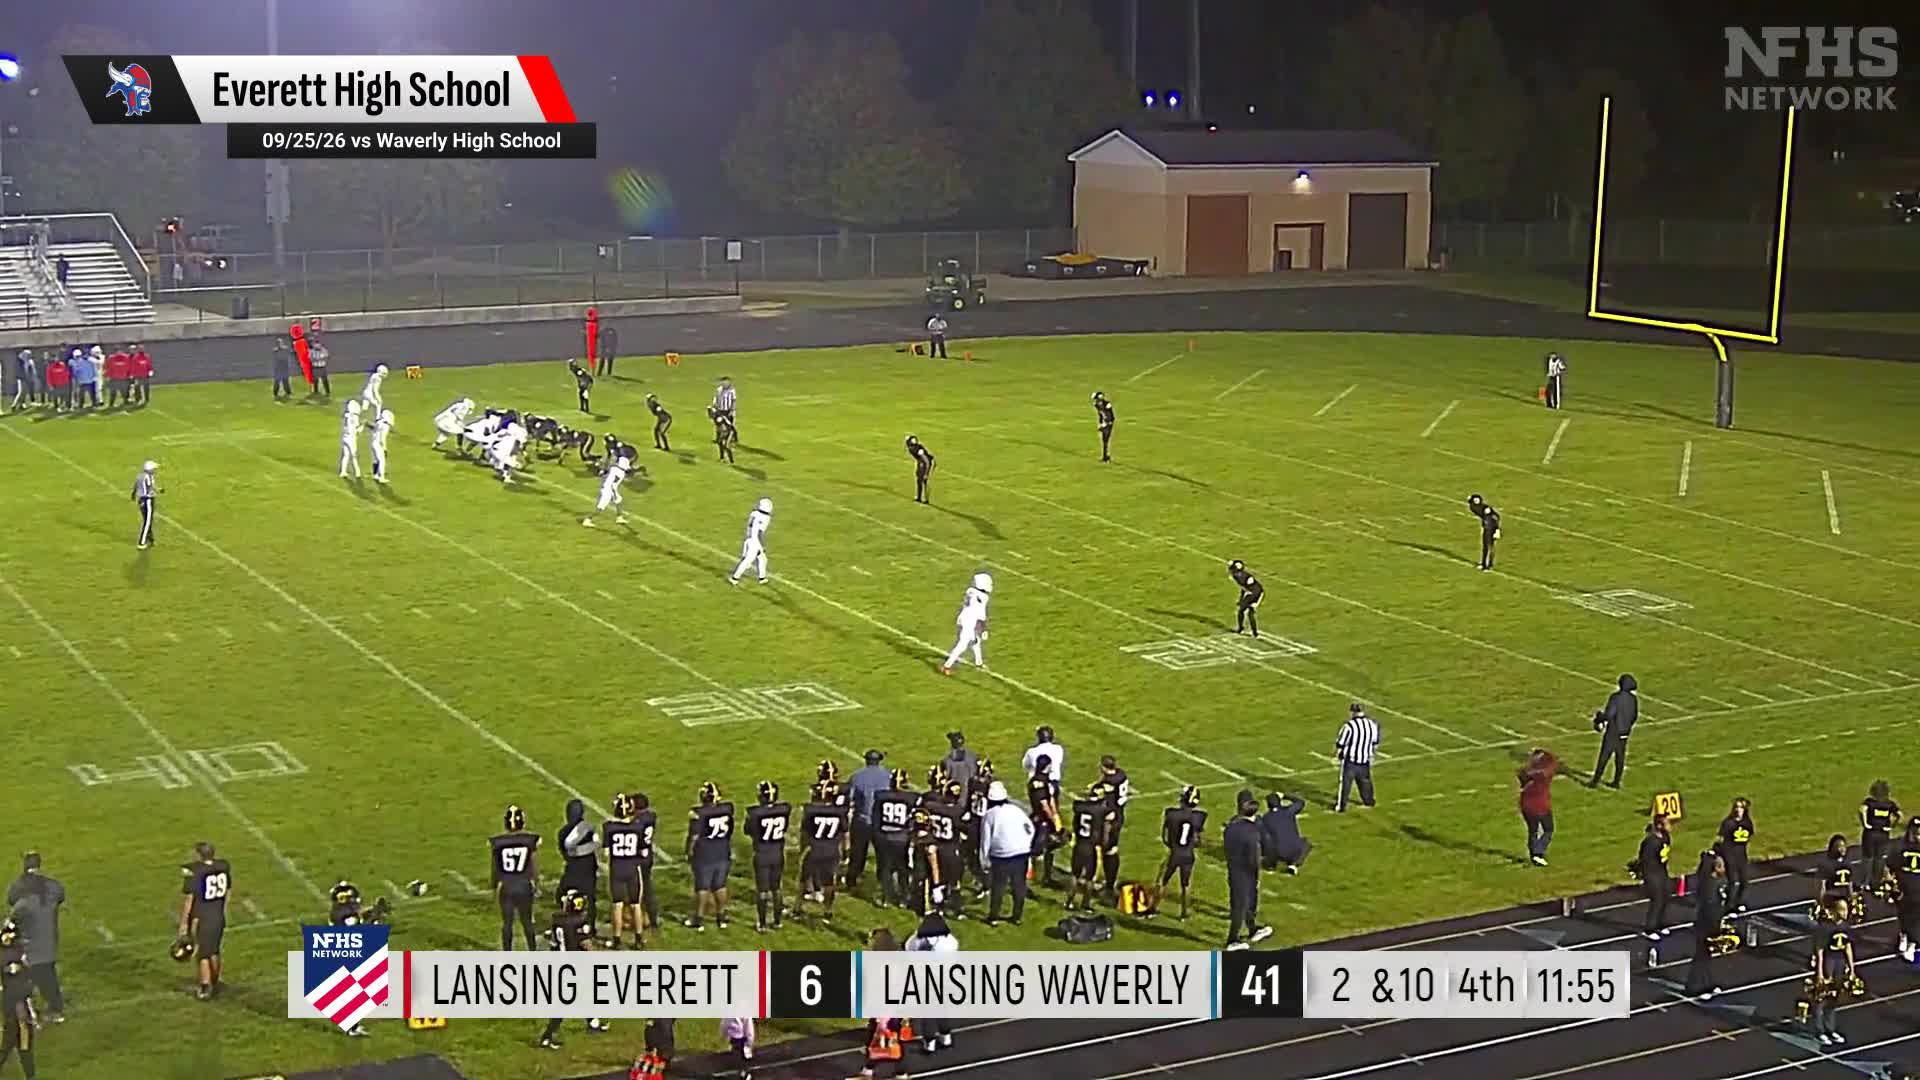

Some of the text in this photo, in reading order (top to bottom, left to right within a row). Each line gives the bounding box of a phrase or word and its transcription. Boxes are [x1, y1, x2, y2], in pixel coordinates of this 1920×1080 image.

[644, 682, 864, 728] 30
[66, 742, 308, 789] 40
[882, 802, 907, 825] 99
[1662, 796, 1678, 816] 20
[707, 815, 729, 839] 75
[761, 816, 785, 840] 72
[814, 816, 840, 838] 77
[1079, 813, 1092, 837] 5
[1180, 822, 1190, 845] 1
[612, 833, 637, 857] 29
[502, 846, 528, 872] 67
[205, 873, 227, 900] 69
